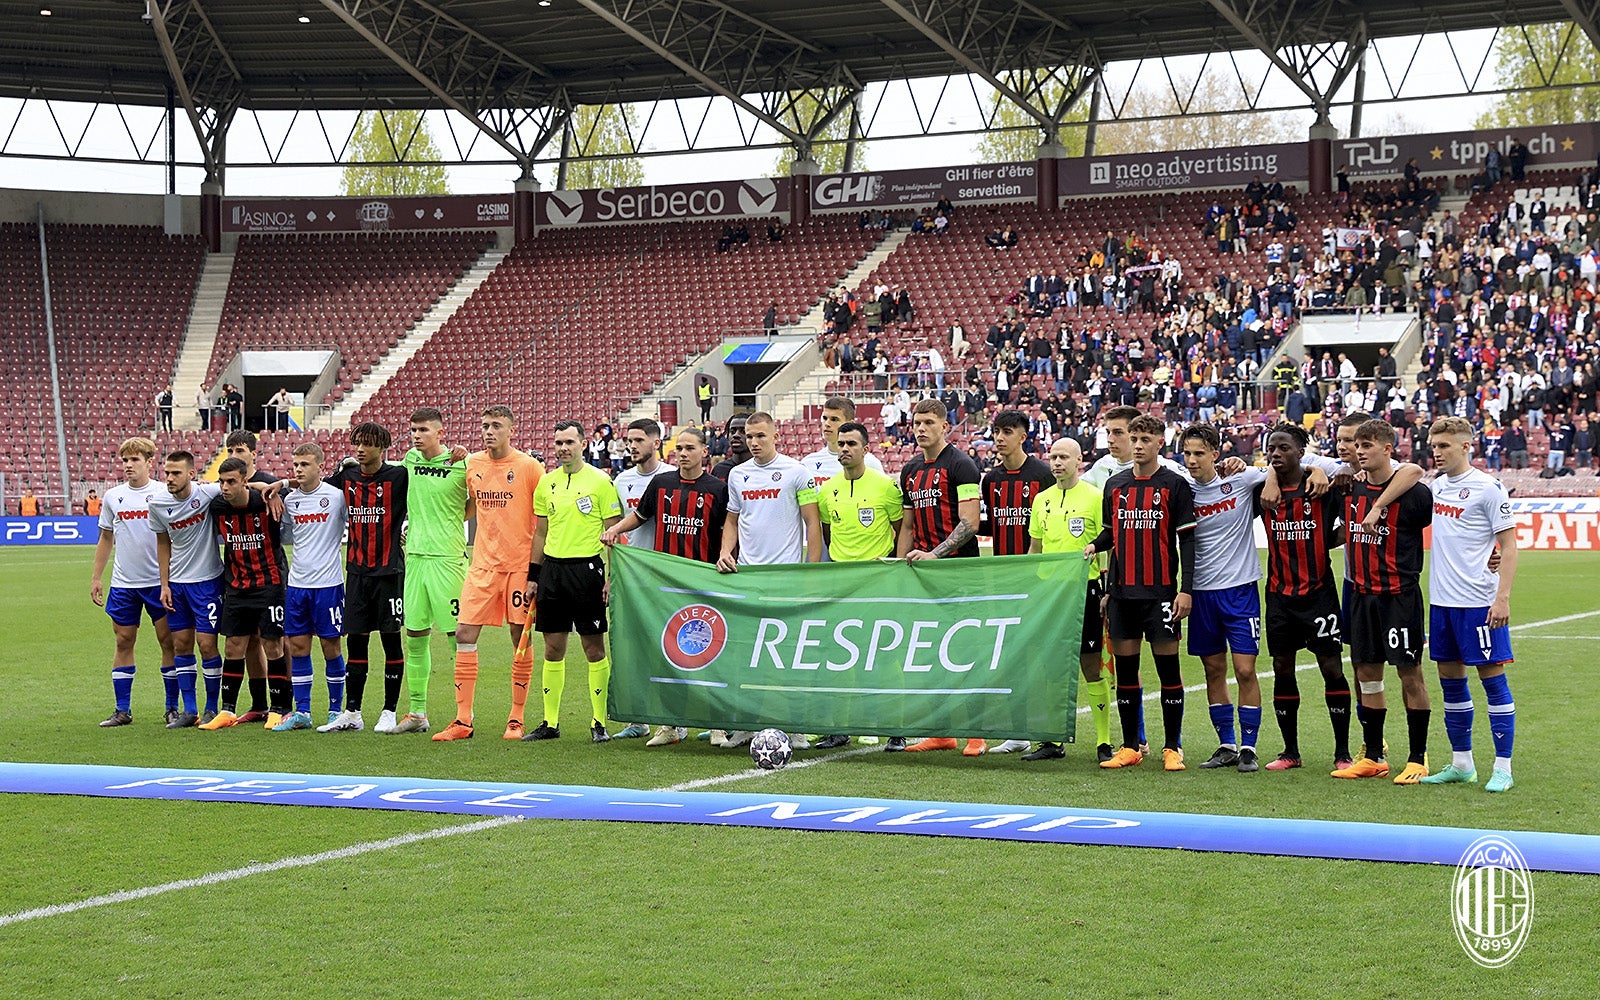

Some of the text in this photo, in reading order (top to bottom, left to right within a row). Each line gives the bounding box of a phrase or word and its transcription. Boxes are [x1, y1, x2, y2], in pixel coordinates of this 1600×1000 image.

[1115, 151, 1278, 180] neo advertising
[946, 168, 970, 182] GHI
[972, 167, 994, 180] fier
[891, 184, 904, 192] Plus
[1115, 175, 1191, 189] SMART OUTDOOR
[814, 176, 877, 206] GHI
[898, 193, 909, 201] que
[910, 191, 930, 200] jamais
[958, 183, 1021, 198] servettien
[477, 203, 509, 216] CASINO
[597, 185, 726, 221] Serbeco
[414, 465, 452, 479] TOMMY
[476, 489, 514, 500] Emirates
[741, 488, 781, 501] TOMMY
[908, 488, 943, 500] Emirates
[348, 505, 386, 515] Emirates
[993, 506, 1033, 518] Emirates
[1117, 508, 1164, 520] Emirates
[1193, 497, 1237, 518] TOMMY
[117, 510, 149, 522] TOMM
[168, 511, 206, 531] TOMMY
[293, 512, 330, 525] TOMMY
[662, 513, 704, 527] Emirates
[666, 524, 698, 536] FLY BETTER
[1123, 520, 1157, 529] FLY BETTER
[1270, 518, 1317, 531] Emirates
[226, 532, 266, 543] Emirates
[1276, 530, 1310, 541] FLY BETTER
[207, 602, 218, 620] 2
[389, 597, 402, 616] 18
[268, 605, 284, 623] 10
[328, 606, 343, 625] 14
[679, 607, 718, 625] UEFA
[1249, 617, 1261, 639] 15
[1314, 613, 1340, 638] 22
[1388, 627, 1410, 649] 61
[1476, 625, 1492, 649] 11
[749, 617, 1022, 673] RESPECT
[105, 776, 585, 809] PEACE
[706, 801, 1142, 833] МИР
